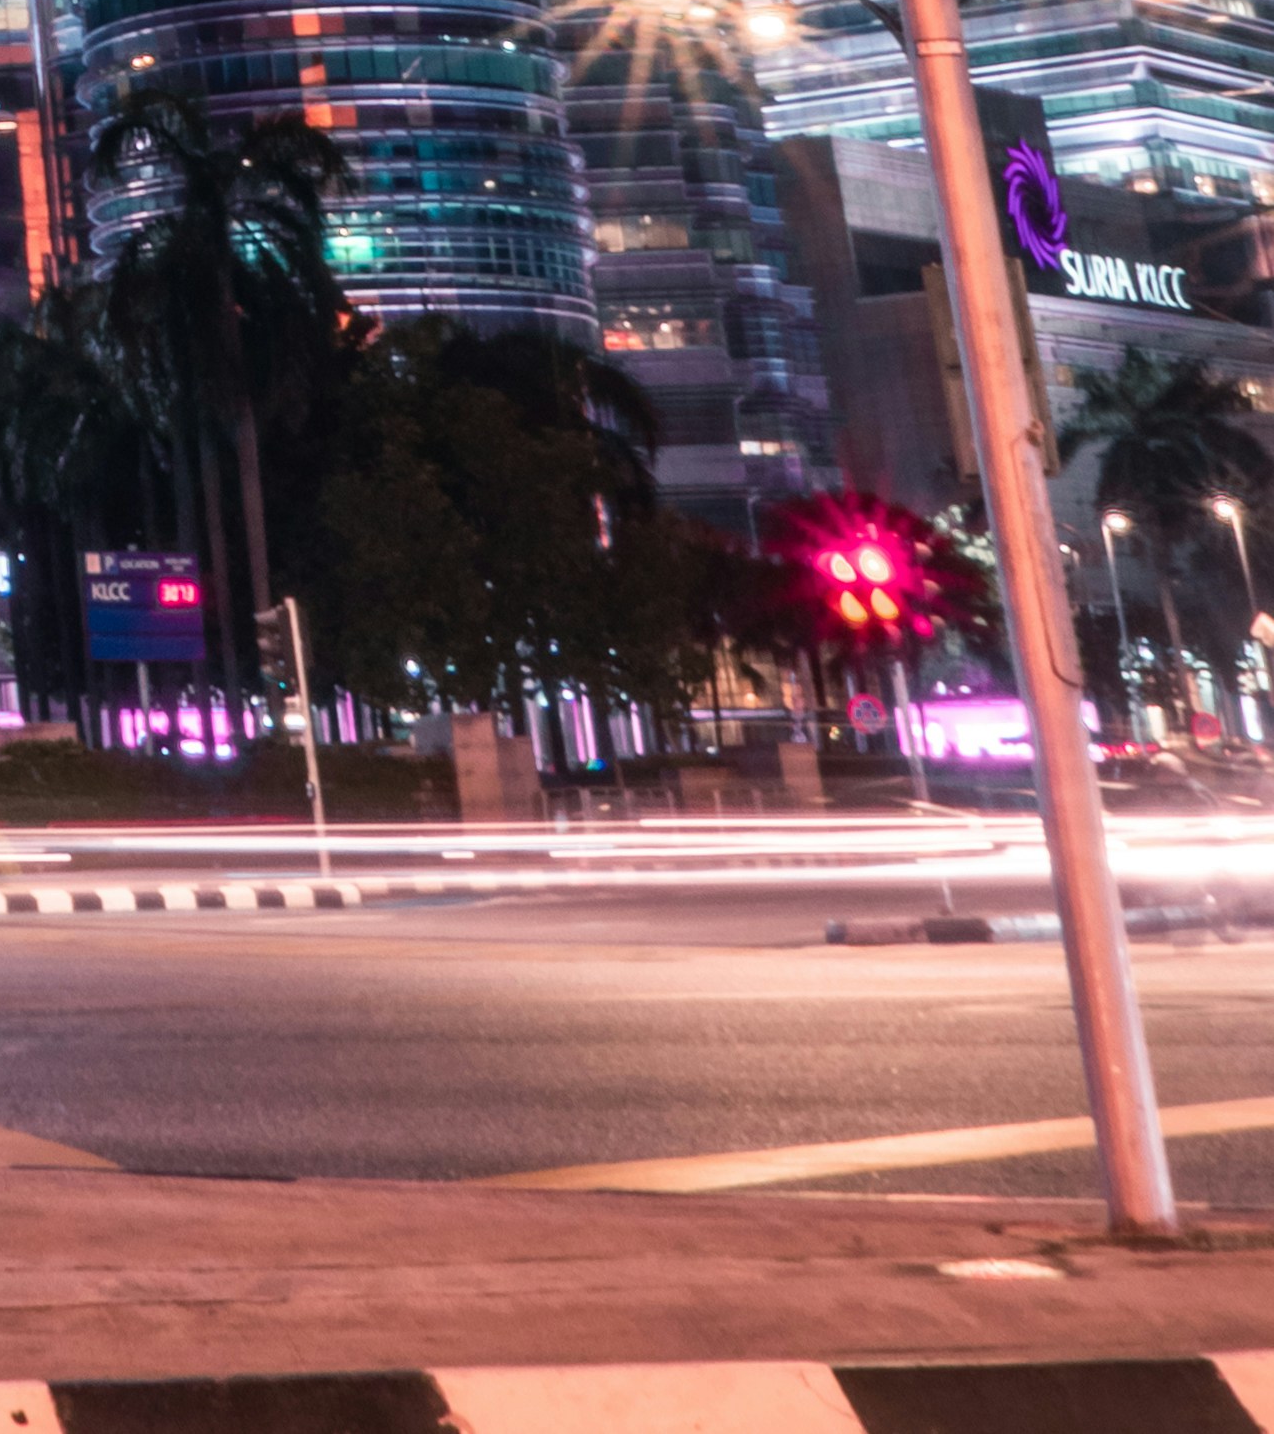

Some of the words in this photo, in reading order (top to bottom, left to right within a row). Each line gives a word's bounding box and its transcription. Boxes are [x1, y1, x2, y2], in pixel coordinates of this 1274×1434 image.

[1060, 248, 1138, 302] SURIA
[1135, 262, 1192, 310] KLCC
[104, 555, 114, 571] P
[91, 582, 131, 601] KLCC
